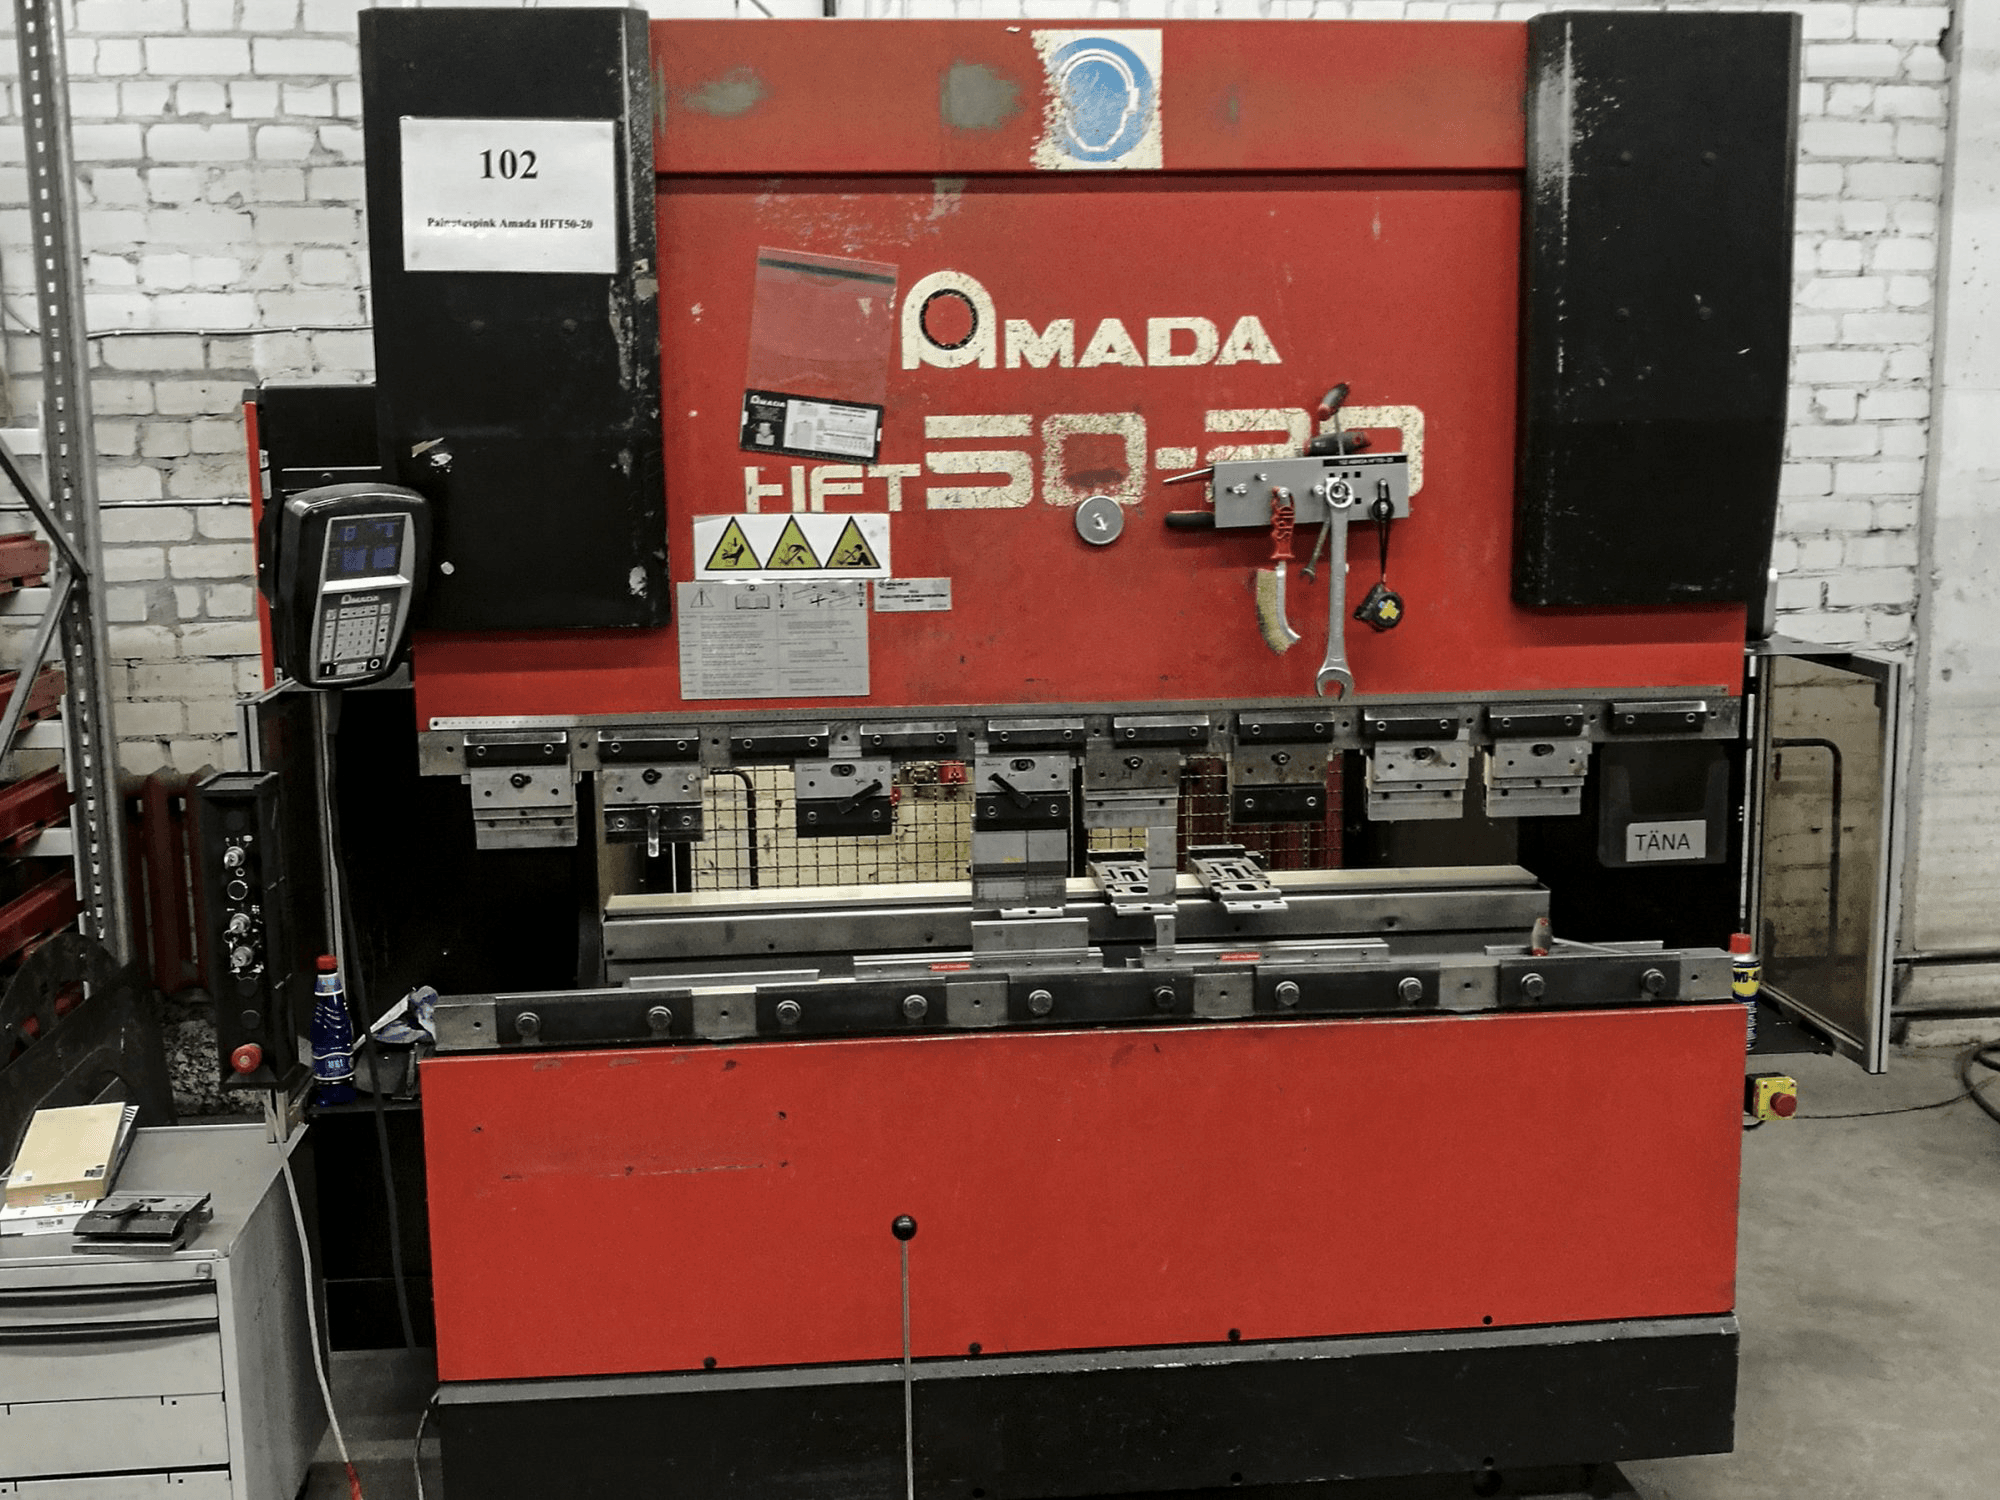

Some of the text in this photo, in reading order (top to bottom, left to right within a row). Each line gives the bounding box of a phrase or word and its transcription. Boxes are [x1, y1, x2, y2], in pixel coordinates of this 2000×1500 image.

[479, 149, 539, 179] 102
[499, 218, 537, 229] Amada
[540, 219, 594, 229] HFT50-20
[902, 270, 1282, 370] AMADA
[750, 394, 786, 408] AMADA
[1635, 830, 1690, 850] TÄNA
[1734, 970, 1759, 984] WD-4
